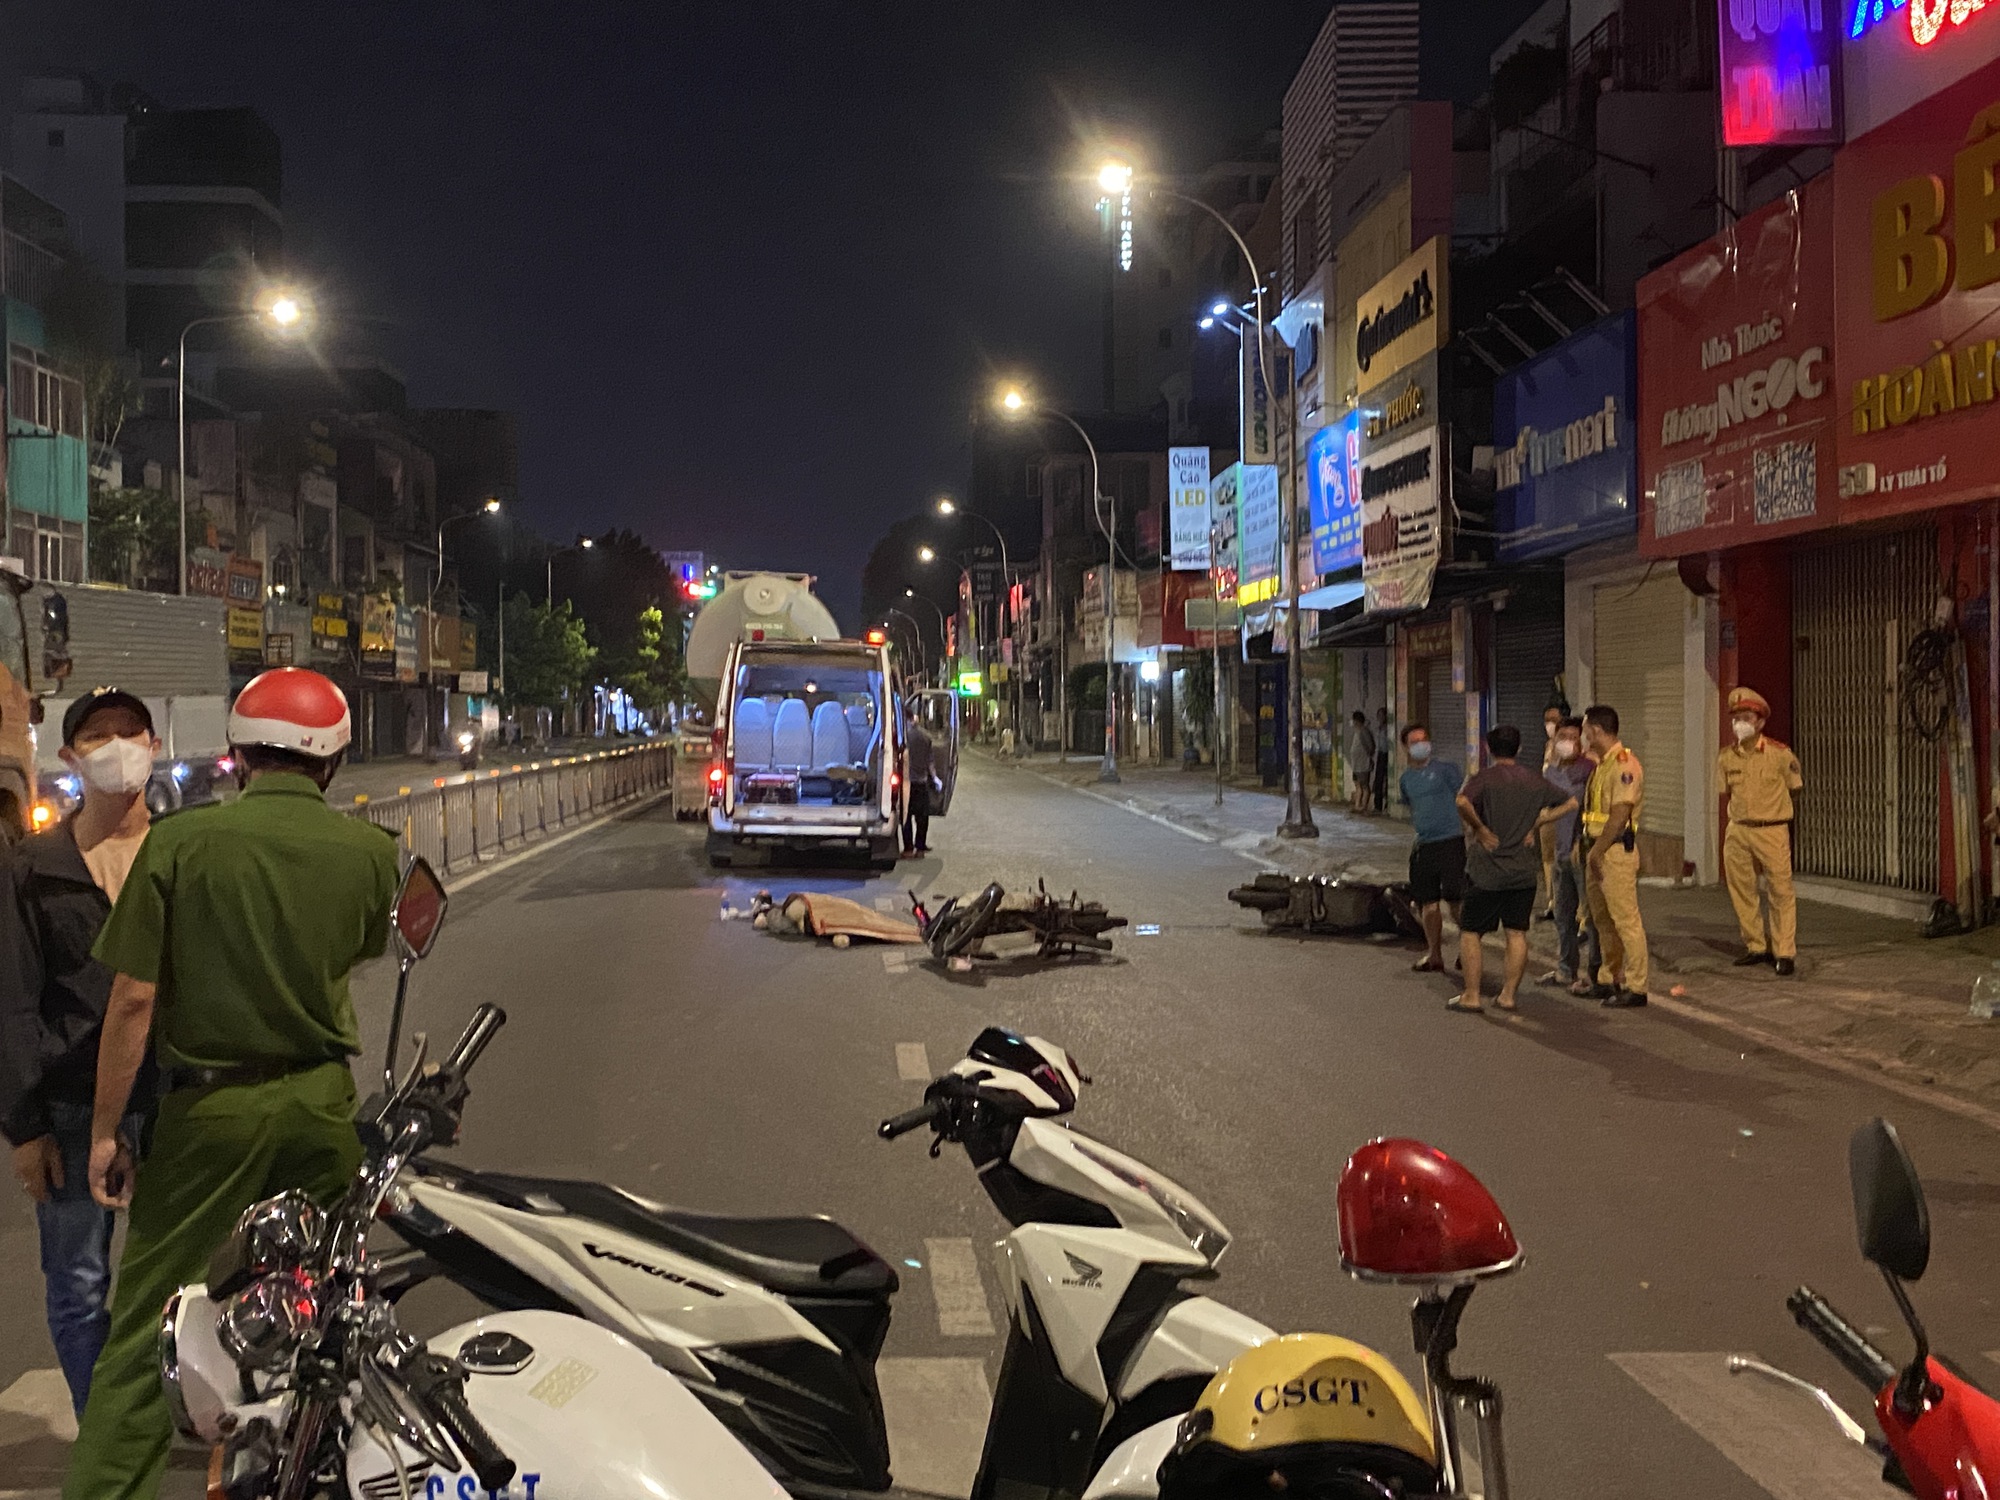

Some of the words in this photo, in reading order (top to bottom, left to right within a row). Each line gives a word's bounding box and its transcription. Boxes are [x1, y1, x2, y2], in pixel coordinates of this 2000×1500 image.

[1717, 346, 1823, 428] NGỌC
[1852, 338, 2000, 436] HOÀN
[1565, 395, 1618, 464] mart
[1172, 451, 1207, 469] Quảng
[1180, 470, 1200, 484] Cáo
[1174, 488, 1206, 507] LED
[1838, 463, 1877, 500] 59
[1880, 471, 1895, 493] LÝ
[1896, 464, 1927, 489] THÁI
[1253, 1376, 1368, 1414] CSGT
[426, 1473, 540, 1500] CST
